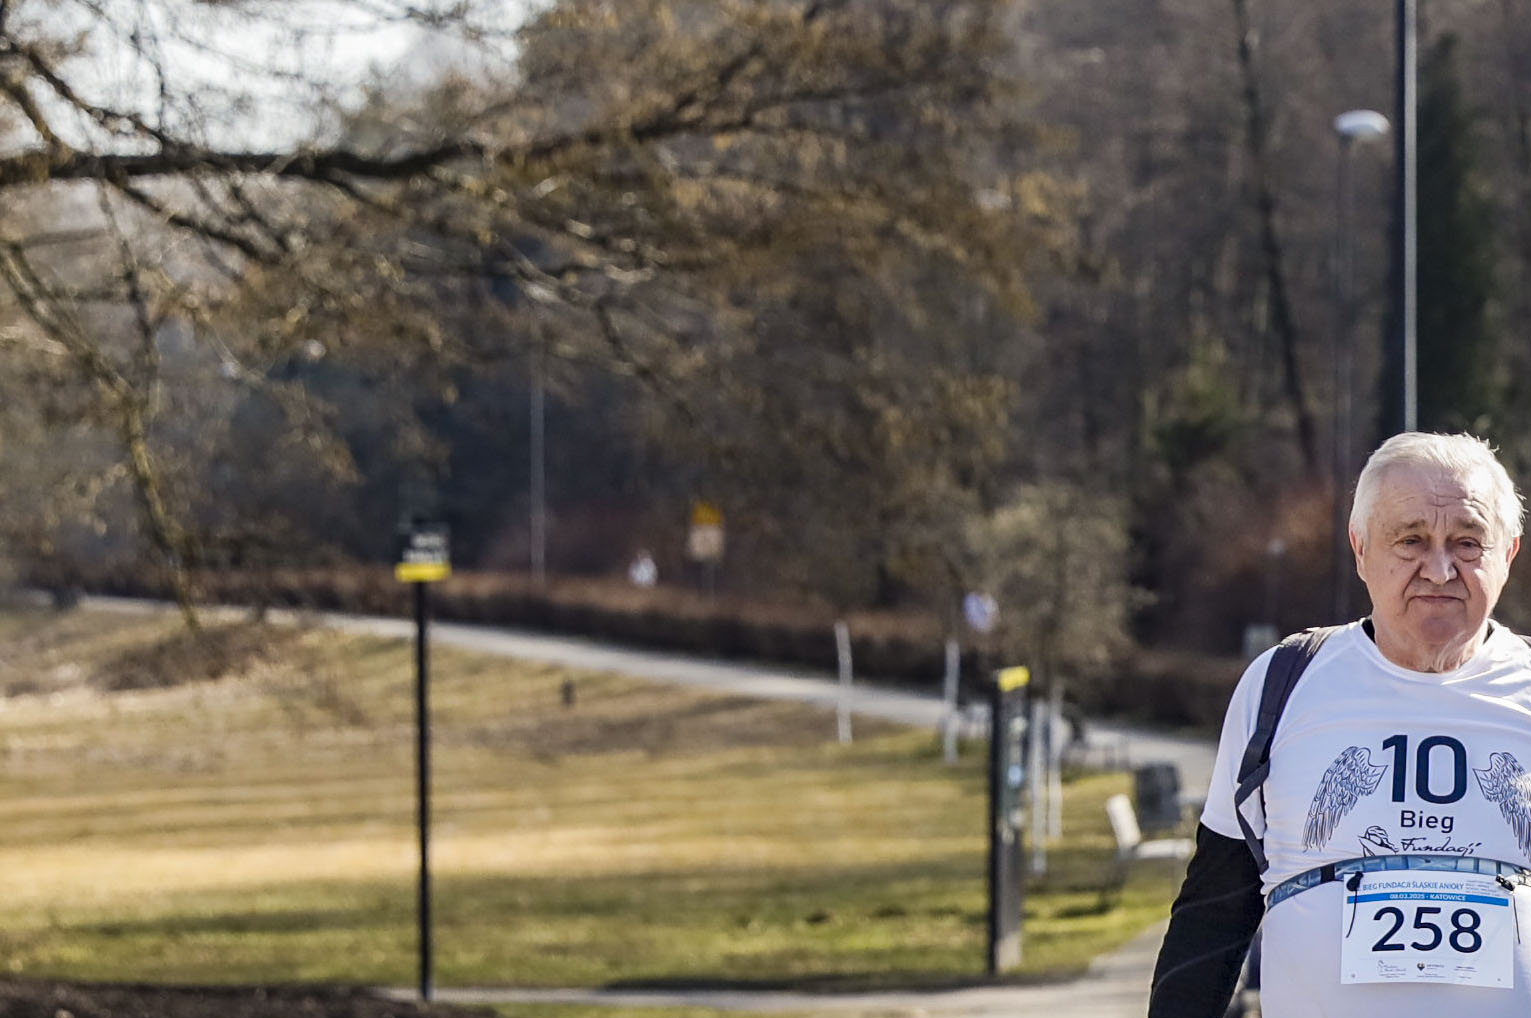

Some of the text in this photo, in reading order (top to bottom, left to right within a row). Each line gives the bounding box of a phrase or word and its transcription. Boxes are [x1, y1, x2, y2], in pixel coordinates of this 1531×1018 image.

[1382, 734, 1468, 804] 10
[1400, 810, 1454, 833] Bieg
[1429, 893, 1466, 901] KATOWICE
[1371, 906, 1483, 953] 258
